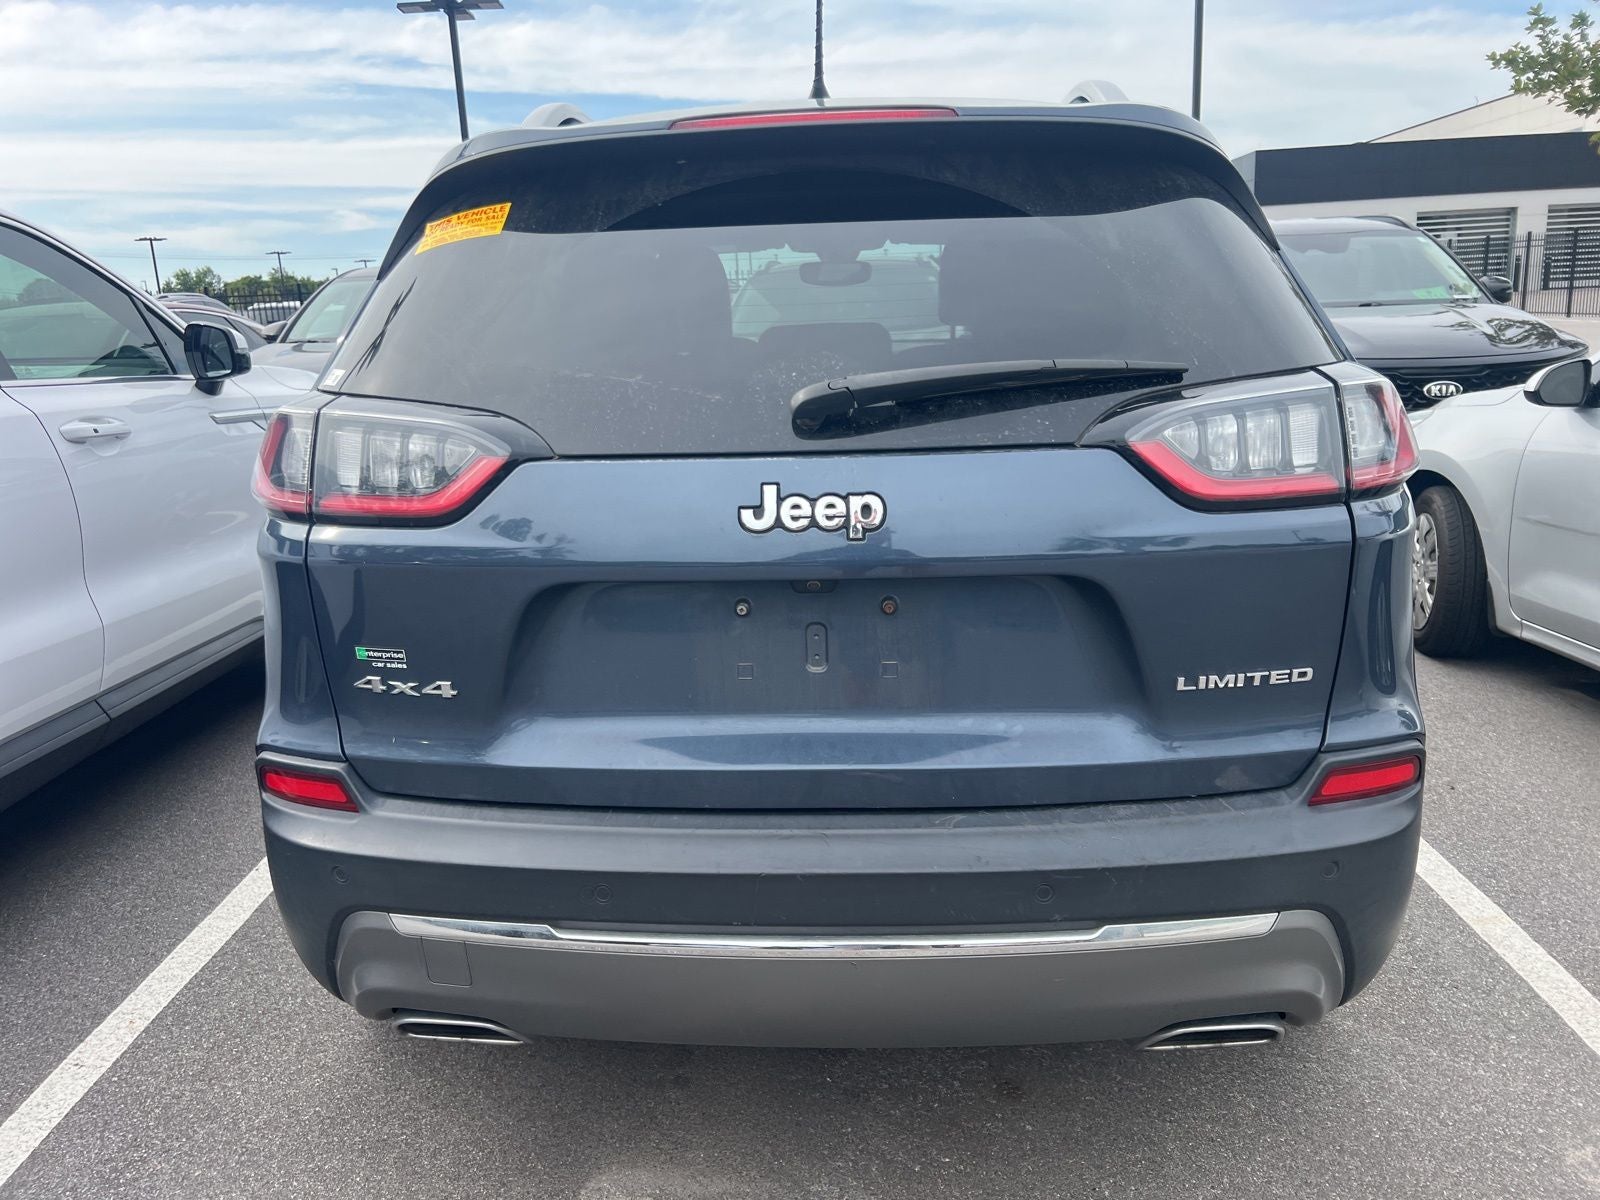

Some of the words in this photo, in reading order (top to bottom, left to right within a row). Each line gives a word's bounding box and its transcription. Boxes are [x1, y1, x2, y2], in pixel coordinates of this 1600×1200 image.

[429, 217, 454, 232] THIS
[457, 205, 507, 220] VEHICLE
[466, 216, 483, 225] FOR
[485, 213, 505, 221] SALE
[1431, 384, 1456, 397] KIA
[738, 482, 887, 541] Jeep
[359, 649, 404, 659] enterprise
[354, 675, 458, 699] 4x4
[1176, 667, 1314, 691] LIMITED
